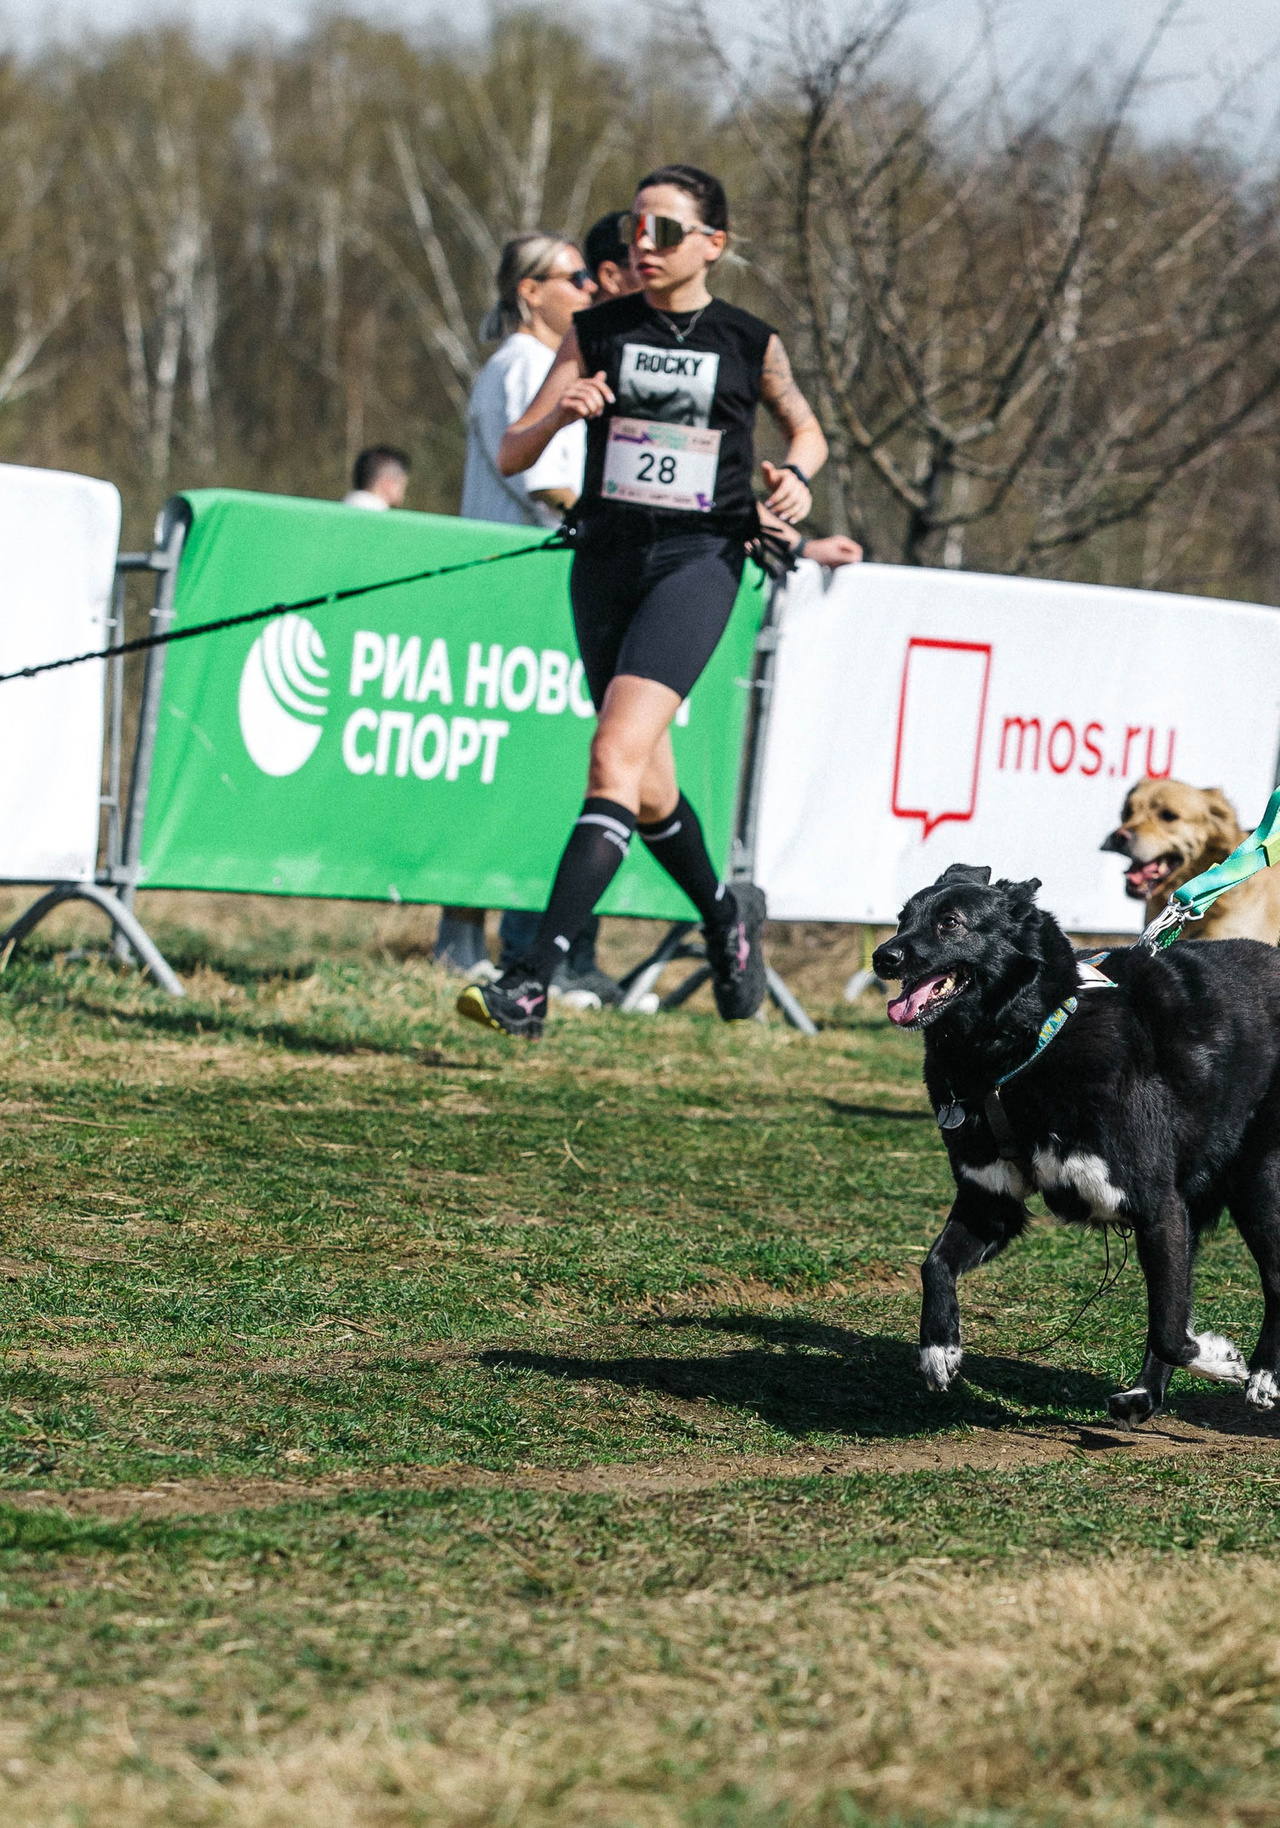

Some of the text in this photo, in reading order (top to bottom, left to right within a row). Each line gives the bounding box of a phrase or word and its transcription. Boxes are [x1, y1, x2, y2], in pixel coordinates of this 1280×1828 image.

[635, 352, 704, 377] ROCKY
[636, 452, 677, 485] 28
[349, 630, 453, 705] РИА
[342, 707, 510, 785] СПОРТ
[998, 716, 1176, 780] mos.ru
